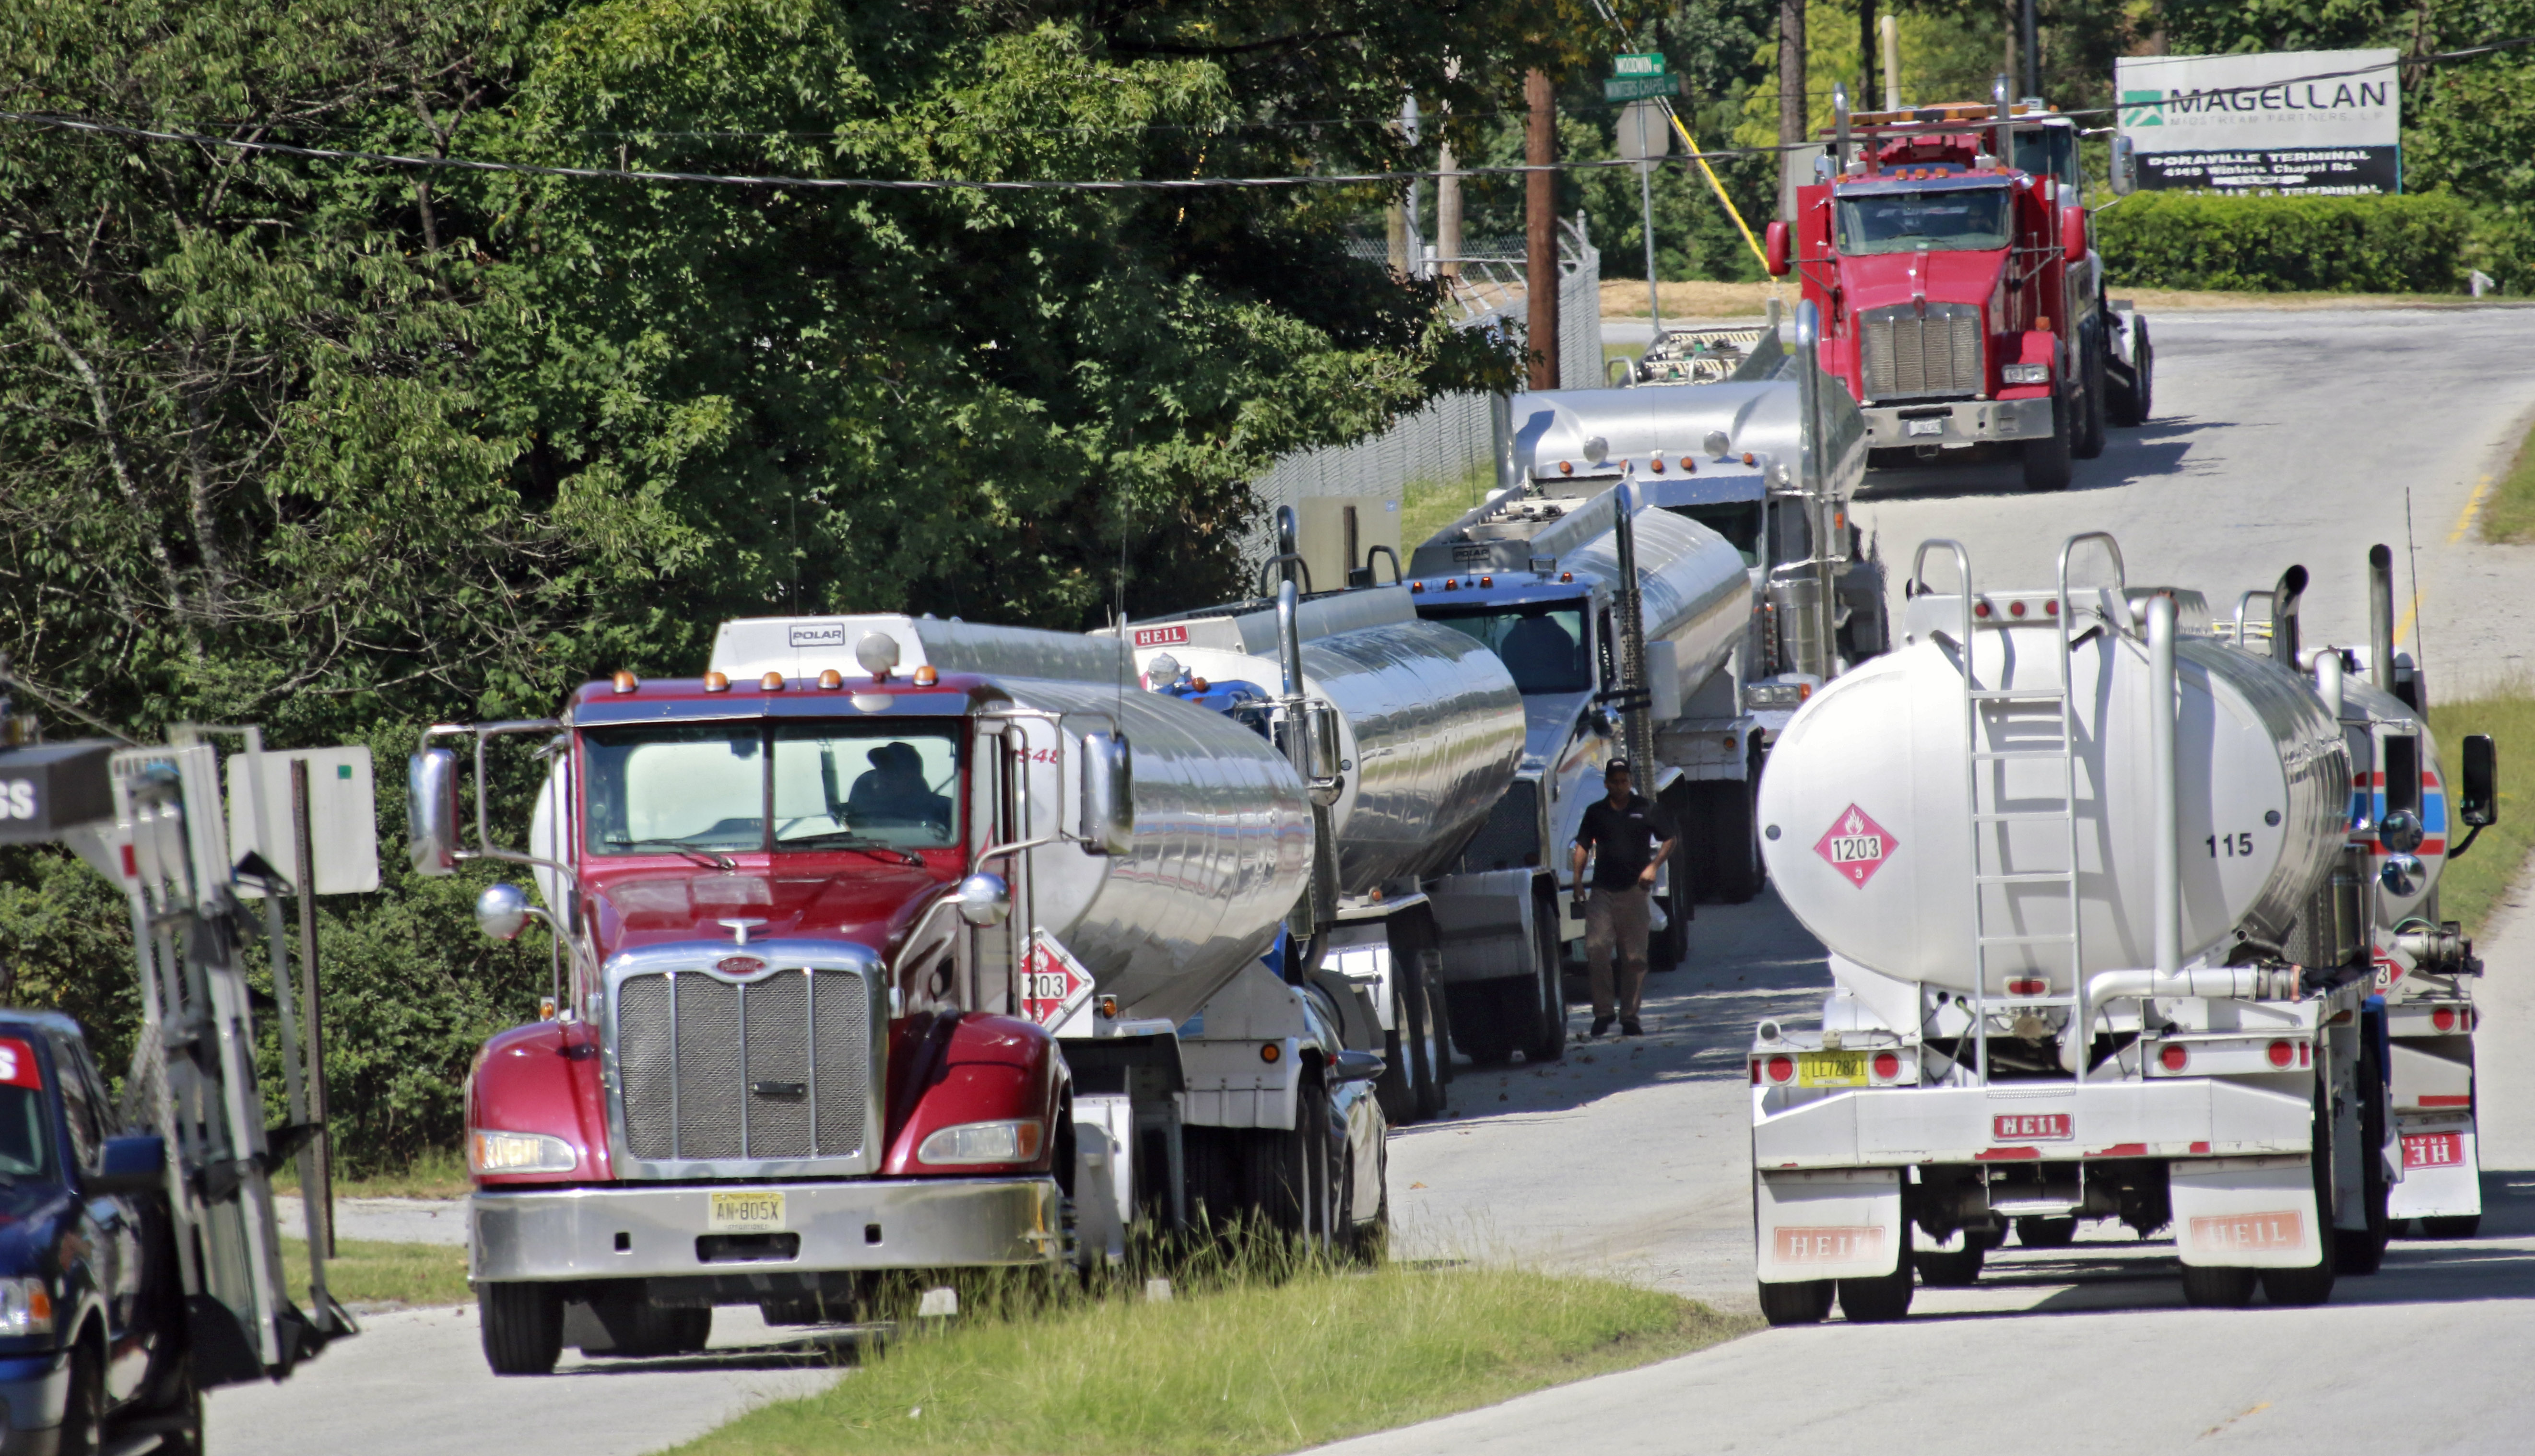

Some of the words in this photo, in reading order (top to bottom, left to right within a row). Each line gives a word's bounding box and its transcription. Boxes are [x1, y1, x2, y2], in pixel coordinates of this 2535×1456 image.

[1616, 57, 1652, 73] WOODWIN
[1639, 78, 1667, 95] CHAPEL
[2171, 82, 2386, 113] MAGELLAN
[2147, 153, 2262, 166] DORAVILLE
[2267, 150, 2372, 163] TERMINAL
[2206, 164, 2268, 176] Winters
[2273, 162, 2327, 174] Chapel
[1455, 549, 1488, 557] POLAR
[792, 630, 842, 640] POLAR
[1140, 628, 1181, 644] HEIL
[1833, 838, 1879, 861] 1203
[2206, 832, 2254, 858] 115
[1855, 868, 1863, 879] 3
[2003, 1115, 2062, 1135] HEIL
[2208, 1222, 2287, 1245] HEIL
[1790, 1236, 1864, 1256] HEIL
